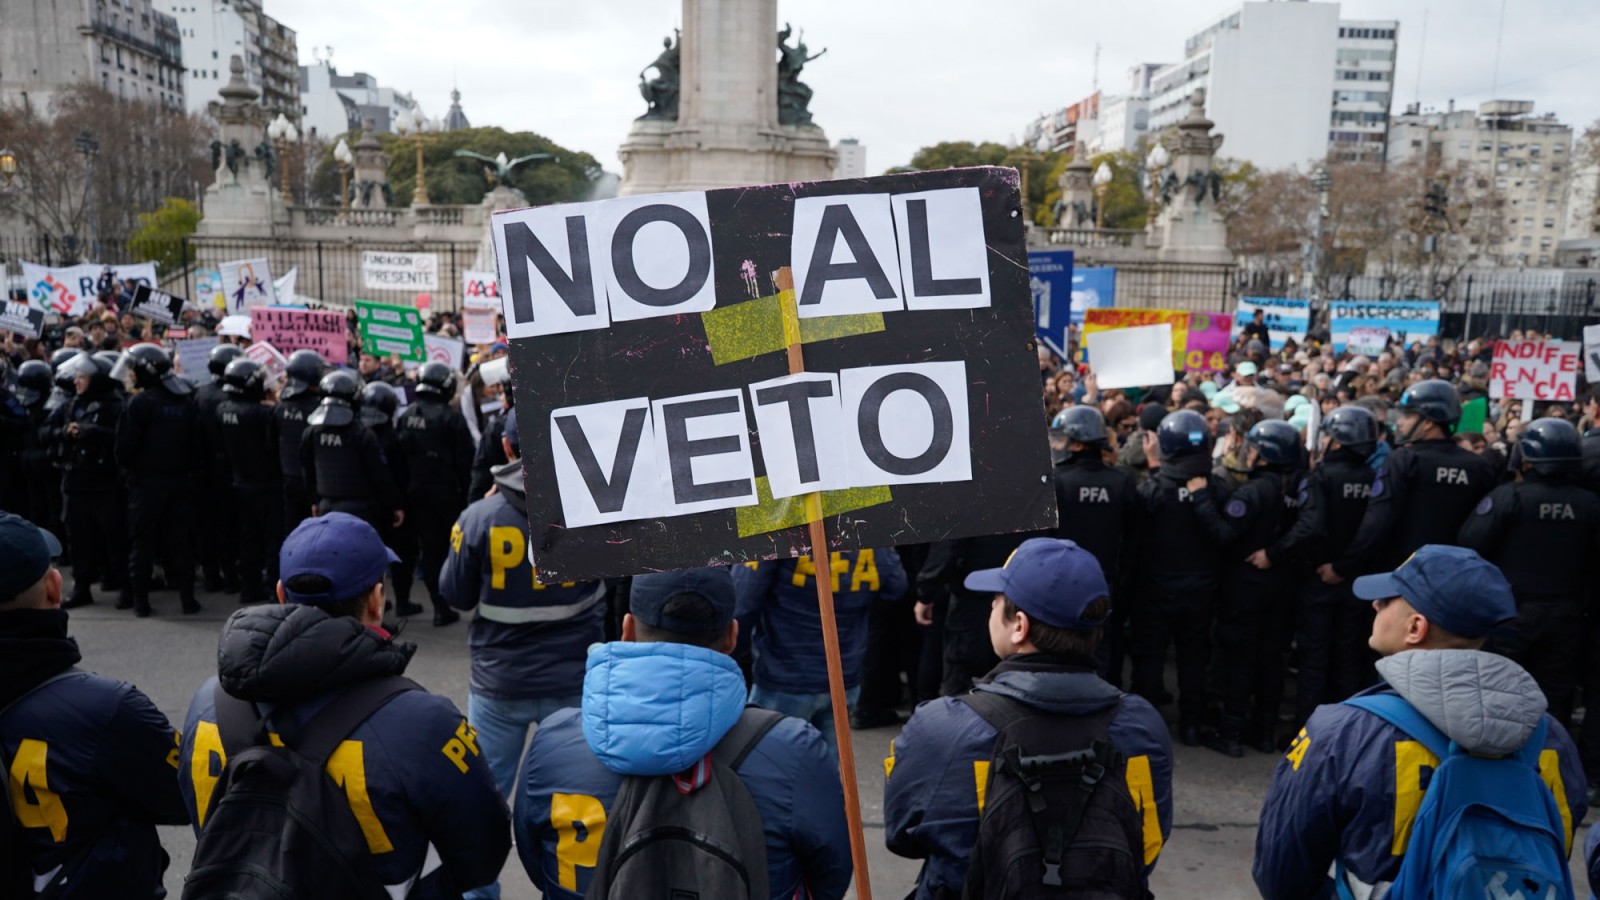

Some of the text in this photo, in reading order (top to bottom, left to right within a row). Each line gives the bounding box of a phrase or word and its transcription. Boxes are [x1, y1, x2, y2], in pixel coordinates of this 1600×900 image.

[504, 198, 983, 324] NO AL
[367, 270, 433, 285] PRESENTE
[148, 290, 171, 307] NO
[223, 412, 239, 425] PFA
[407, 415, 426, 429] PFA
[320, 433, 342, 446] PFA
[554, 371, 954, 514] VETO
[1436, 466, 1469, 485] PFA
[1080, 487, 1109, 502] PFA
[1343, 483, 1371, 498] PFA
[1539, 503, 1575, 519] PFA
